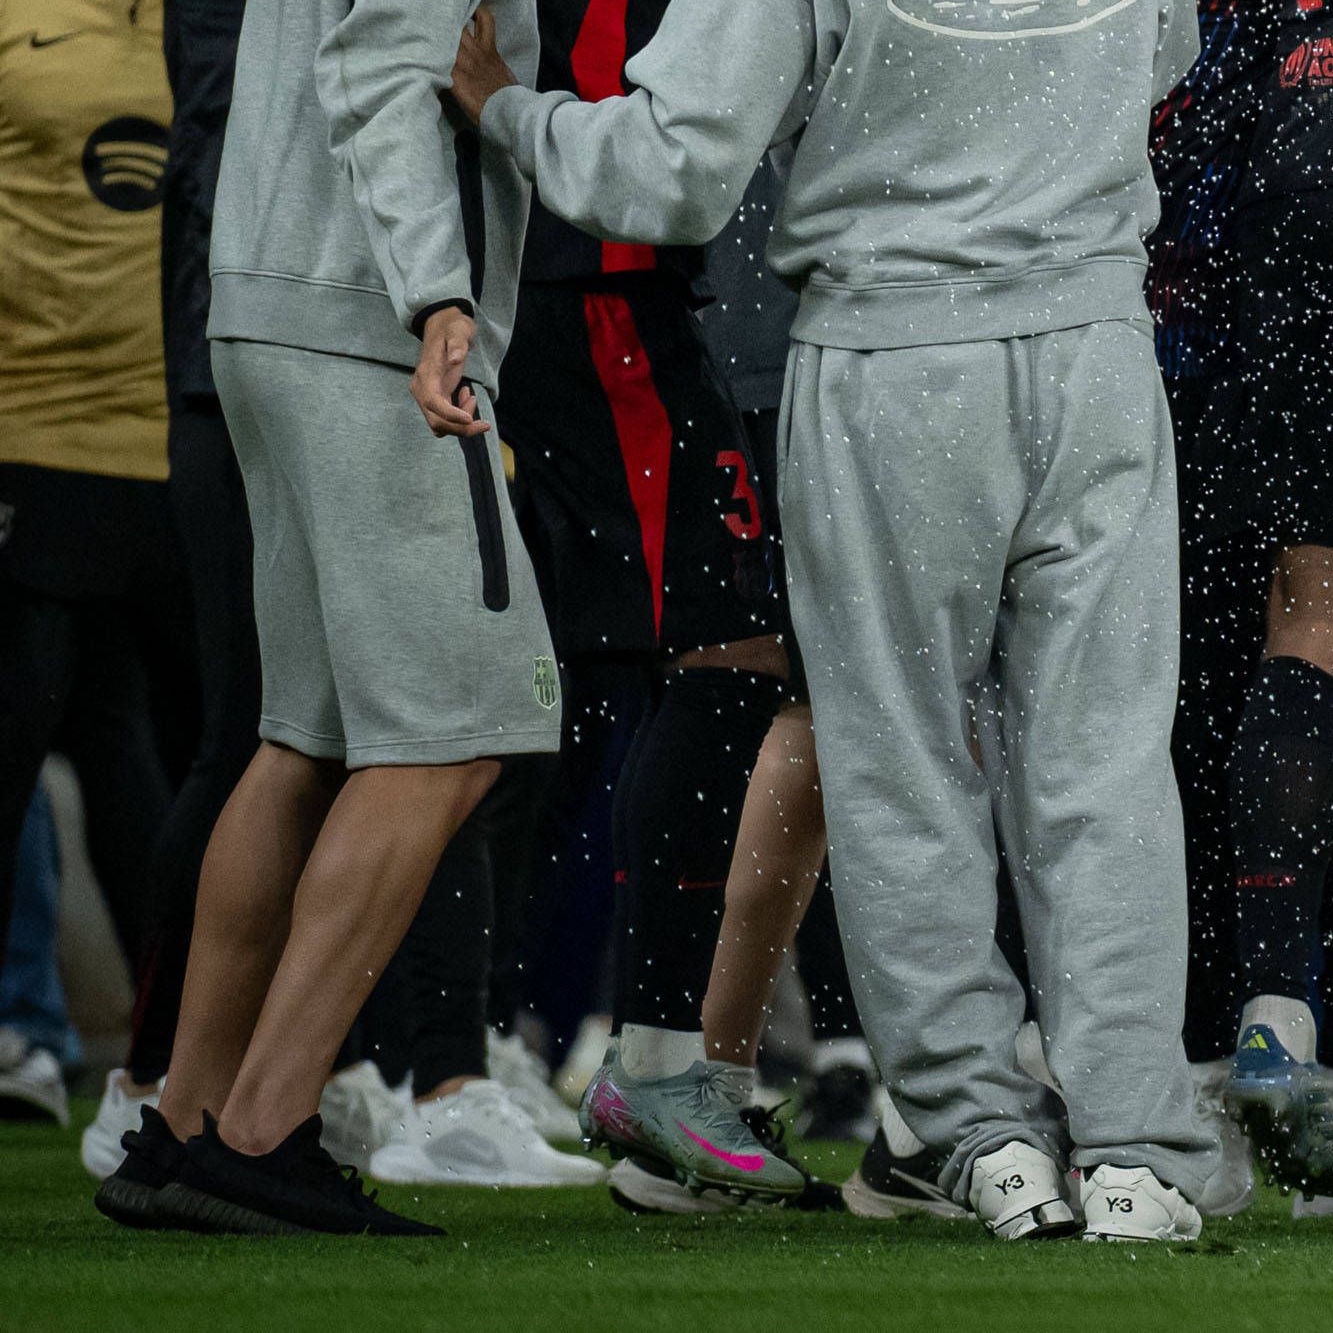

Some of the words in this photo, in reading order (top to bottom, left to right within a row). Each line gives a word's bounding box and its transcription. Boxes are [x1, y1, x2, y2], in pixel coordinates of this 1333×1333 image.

[716, 450, 762, 541] 3
[994, 1173, 1025, 1196] Y-3
[1105, 1196, 1133, 1214] Y-3
